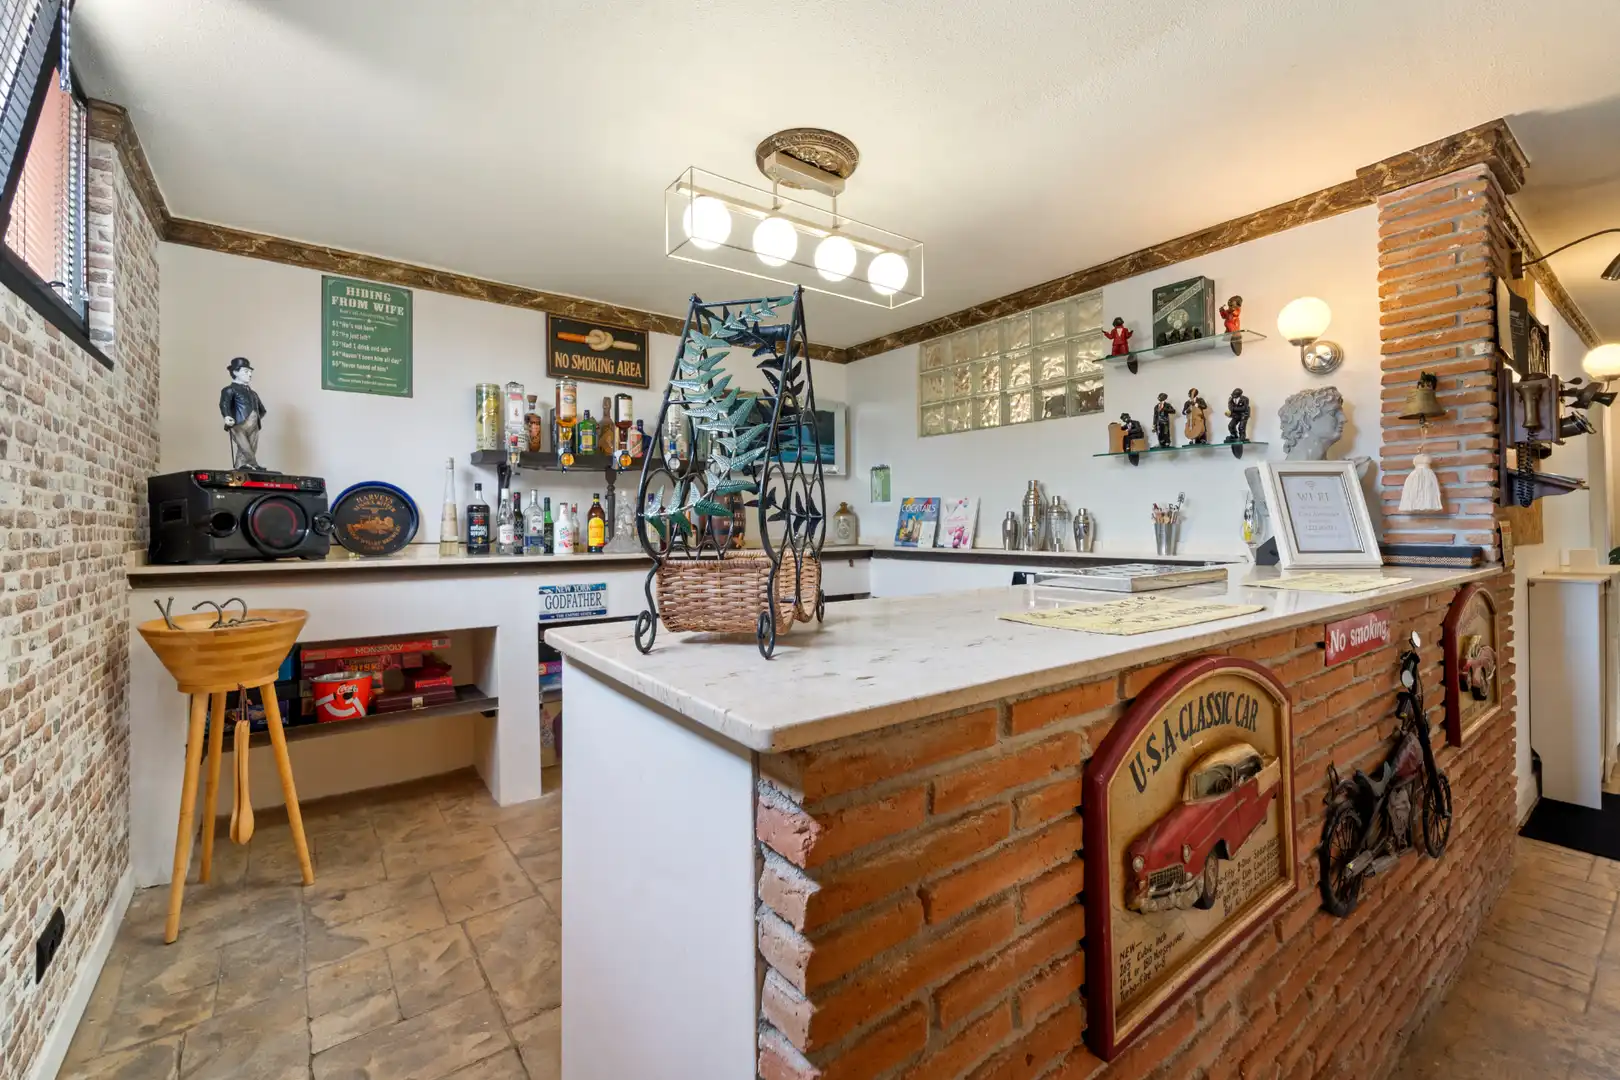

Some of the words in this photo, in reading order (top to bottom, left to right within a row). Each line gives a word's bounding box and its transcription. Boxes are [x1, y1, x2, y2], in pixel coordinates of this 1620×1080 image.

[346, 286, 391, 302] HIDING
[331, 296, 368, 310] FROM
[373, 302, 404, 316] WIFE
[554, 351, 570, 369] NO
[571, 354, 615, 374] SMOKING
[616, 360, 643, 378] AREA
[901, 503, 937, 513] COCKTAILS
[556, 585, 575, 594] NEW
[575, 583, 590, 592] YORK
[545, 591, 602, 610] GODFATHER
[1330, 628, 1347, 656] No
[1350, 620, 1387, 647] smoking
[355, 643, 404, 655] MONOPOLY
[1179, 691, 1235, 742] CLASSIC
[1235, 693, 1259, 733] CAR
